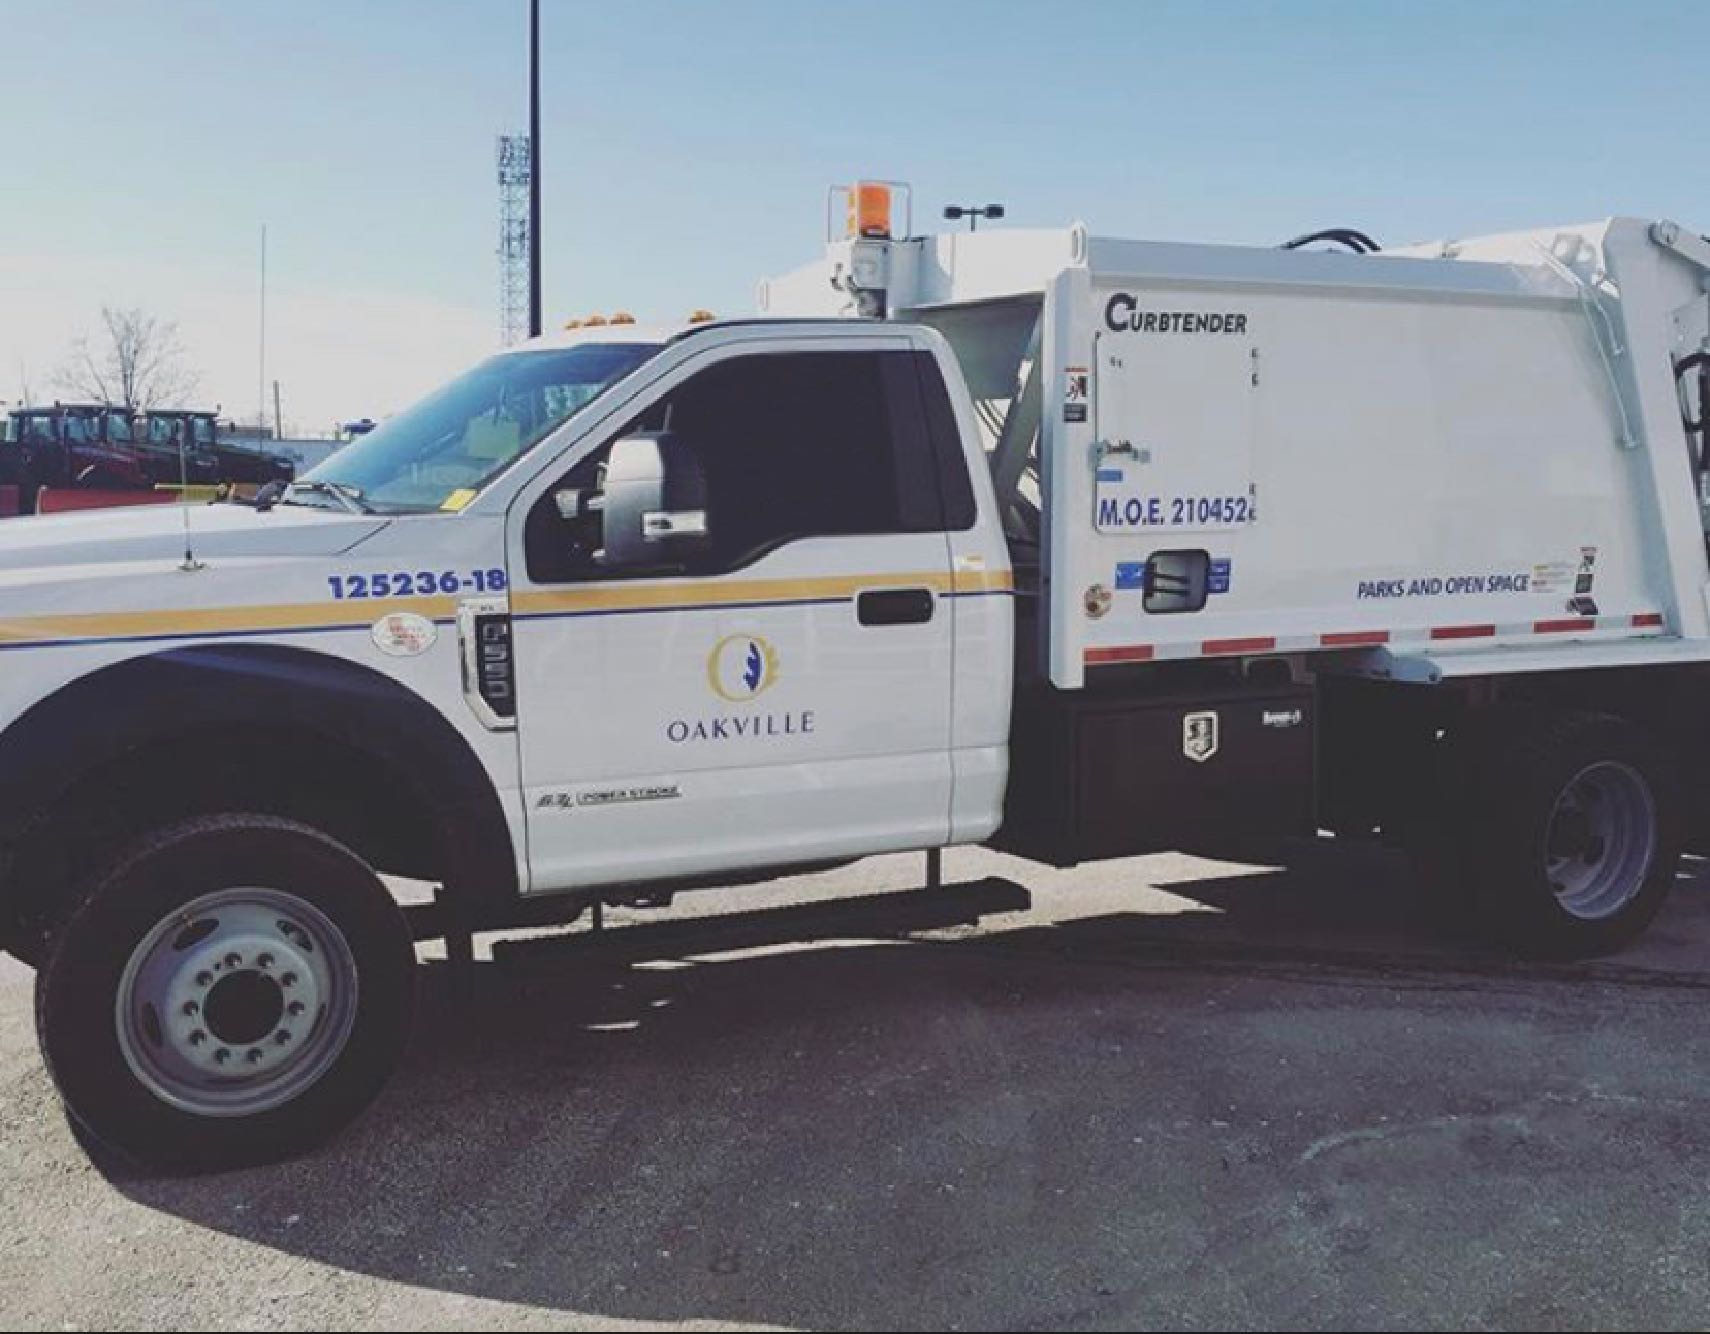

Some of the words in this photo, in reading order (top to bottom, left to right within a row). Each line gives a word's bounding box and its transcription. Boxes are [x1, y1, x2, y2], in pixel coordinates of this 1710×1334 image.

[1105, 293, 1248, 333] CURBTENDER
[1100, 498, 1164, 526] M.O.E.
[1171, 497, 1248, 524] 210452
[328, 568, 507, 599] 125236-18
[1358, 580, 1405, 599] PARKS
[1407, 578, 1443, 596] AND
[1446, 576, 1486, 594] OPEN
[1487, 574, 1530, 592] SPACE
[666, 710, 815, 742] OAKVILLE
